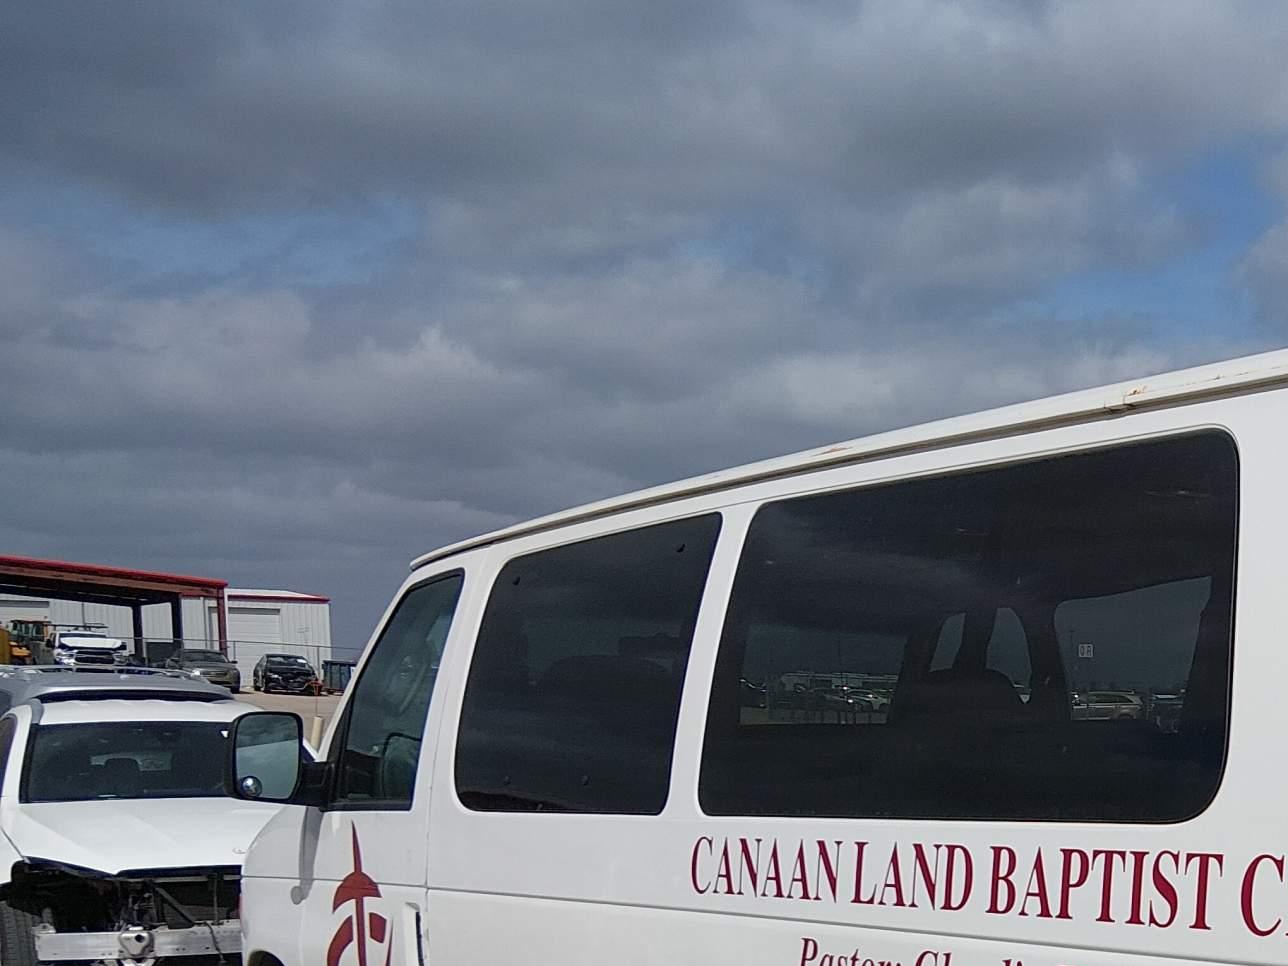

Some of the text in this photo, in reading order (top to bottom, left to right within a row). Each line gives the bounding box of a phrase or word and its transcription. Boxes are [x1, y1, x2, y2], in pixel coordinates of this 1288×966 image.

[690, 835, 843, 904] CANAAN
[851, 840, 974, 912] LAND
[985, 845, 1224, 930] BAPTIST
